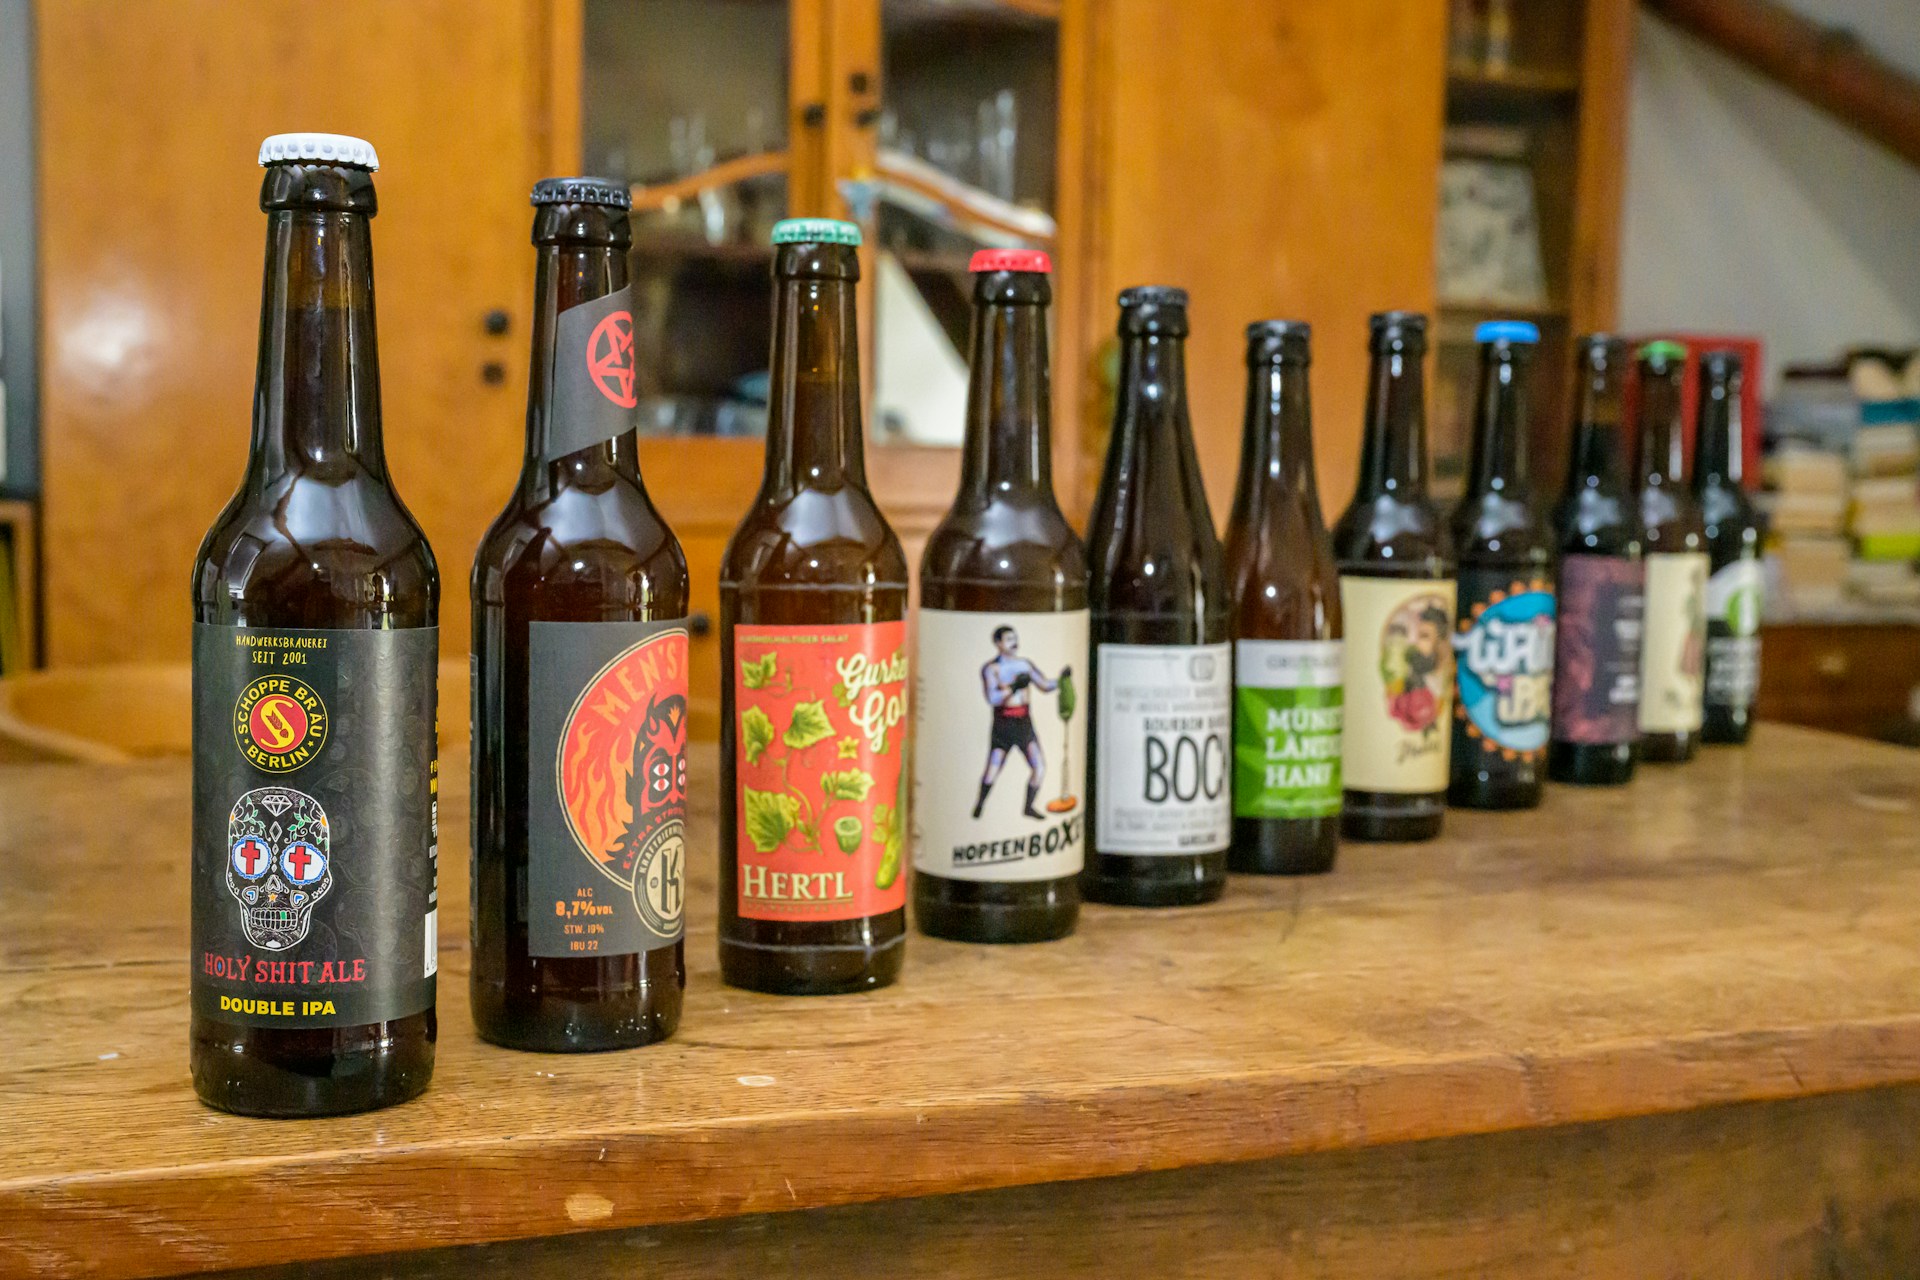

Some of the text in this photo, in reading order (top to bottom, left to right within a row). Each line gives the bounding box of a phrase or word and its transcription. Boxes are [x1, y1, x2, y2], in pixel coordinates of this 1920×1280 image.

[236, 635, 327, 648] HANDWERKSBRAUEREI
[252, 651, 307, 665] SEIT 2001
[590, 641, 678, 726] MEN'S
[238, 679, 326, 738] SCHOPPE BRÄU
[247, 745, 310, 768] BERLIN
[577, 888, 593, 897] ALC
[743, 864, 853, 900] HERTL
[570, 941, 598, 951] IBU 22
[204, 952, 367, 984] HOLY SHIT ALE
[220, 995, 336, 1016] DOUBLE IPA
